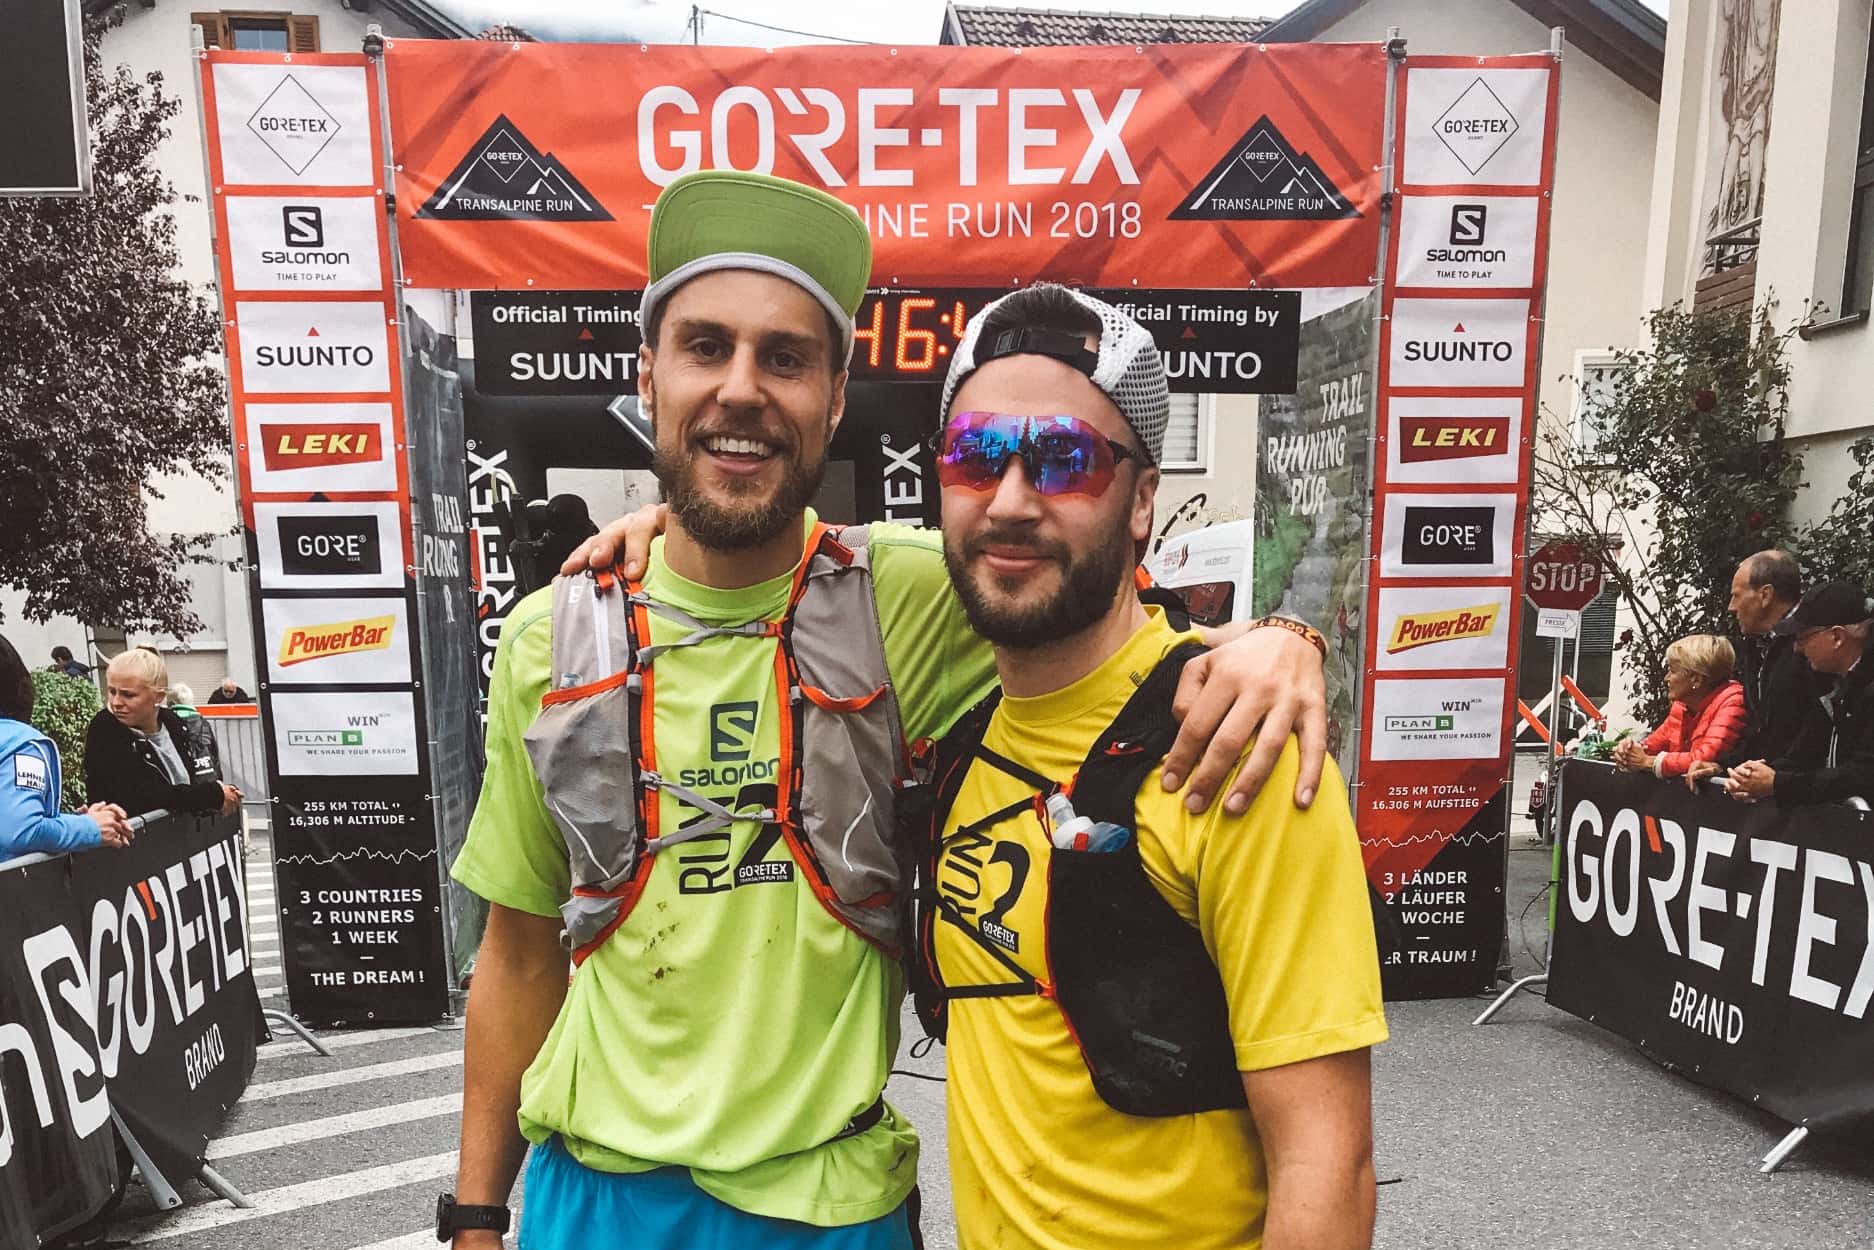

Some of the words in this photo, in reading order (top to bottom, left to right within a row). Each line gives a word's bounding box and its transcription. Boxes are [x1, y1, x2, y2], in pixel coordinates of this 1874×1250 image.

[260, 117, 328, 132] GORE-TEX
[1444, 119, 1508, 133] GORE-TEX
[637, 85, 1142, 187] GORE-TEX
[487, 152, 523, 161] GORE-TEX
[1245, 152, 1279, 161] GORE-TEX
[456, 198, 542, 212] TRANSALPINE
[546, 200, 573, 212] RUN
[1212, 198, 1294, 211] TRANSALPINE
[1298, 198, 1324, 210] RUN
[948, 203, 1032, 237] RUN
[1051, 202, 1142, 238] 2018
[277, 273, 297, 281] TIME
[301, 273, 313, 281] TO
[1437, 270, 1456, 279] TIME
[1458, 271, 1469, 279] TO
[1471, 271, 1492, 279] PLAY
[492, 306, 567, 323] Official
[1178, 305, 1247, 326] Timing
[1255, 306, 1280, 327] by
[256, 345, 373, 366] SUUNTO
[1404, 341, 1513, 362] SUUNTO
[510, 352, 641, 381] SUUNT
[1320, 372, 1364, 423] TRAIL
[278, 434, 368, 454] LEKI
[1412, 428, 1497, 447] LEKI
[1267, 425, 1348, 474] RUNNING
[1531, 562, 1596, 592] STOP
[1397, 612, 1492, 643] PowerBar
[287, 624, 388, 656] PowerBar
[1441, 701, 1471, 712] WIN
[348, 716, 379, 727] WIN
[1391, 720, 1432, 728] PLAN
[294, 735, 338, 743] PLAN
[1388, 786, 1409, 796] 255
[1412, 786, 1429, 796] KM
[1432, 785, 1465, 795] TOTAL
[303, 801, 326, 812] 255
[330, 801, 348, 812] KM
[351, 801, 389, 811] TOTAL
[1372, 800, 1410, 810] 16.306
[1413, 800, 1422, 809] M
[1425, 798, 1480, 809] AUFSTIEG
[289, 816, 330, 827] 16,306
[333, 816, 344, 826] M
[347, 814, 406, 826] ALTITUDE
[739, 863, 787, 878] GORE-TEX
[1383, 872, 1394, 885] 3
[1401, 869, 1468, 885] LÄNDER
[300, 890, 312, 904] 3
[318, 888, 423, 904] COUNTRIES
[1385, 892, 1395, 905] 2
[1401, 889, 1466, 905] LÄUFER
[312, 911, 323, 925] 2
[330, 909, 415, 924] RUNNERS
[1401, 911, 1465, 925] WOCHE
[331, 931, 342, 945] 1
[349, 930, 400, 944] WEEK
[982, 920, 1015, 945] GORE-TEX
[310, 972, 346, 986] THE
[1669, 981, 1744, 1045] BRAND
[185, 1023, 225, 1091] BRAND
